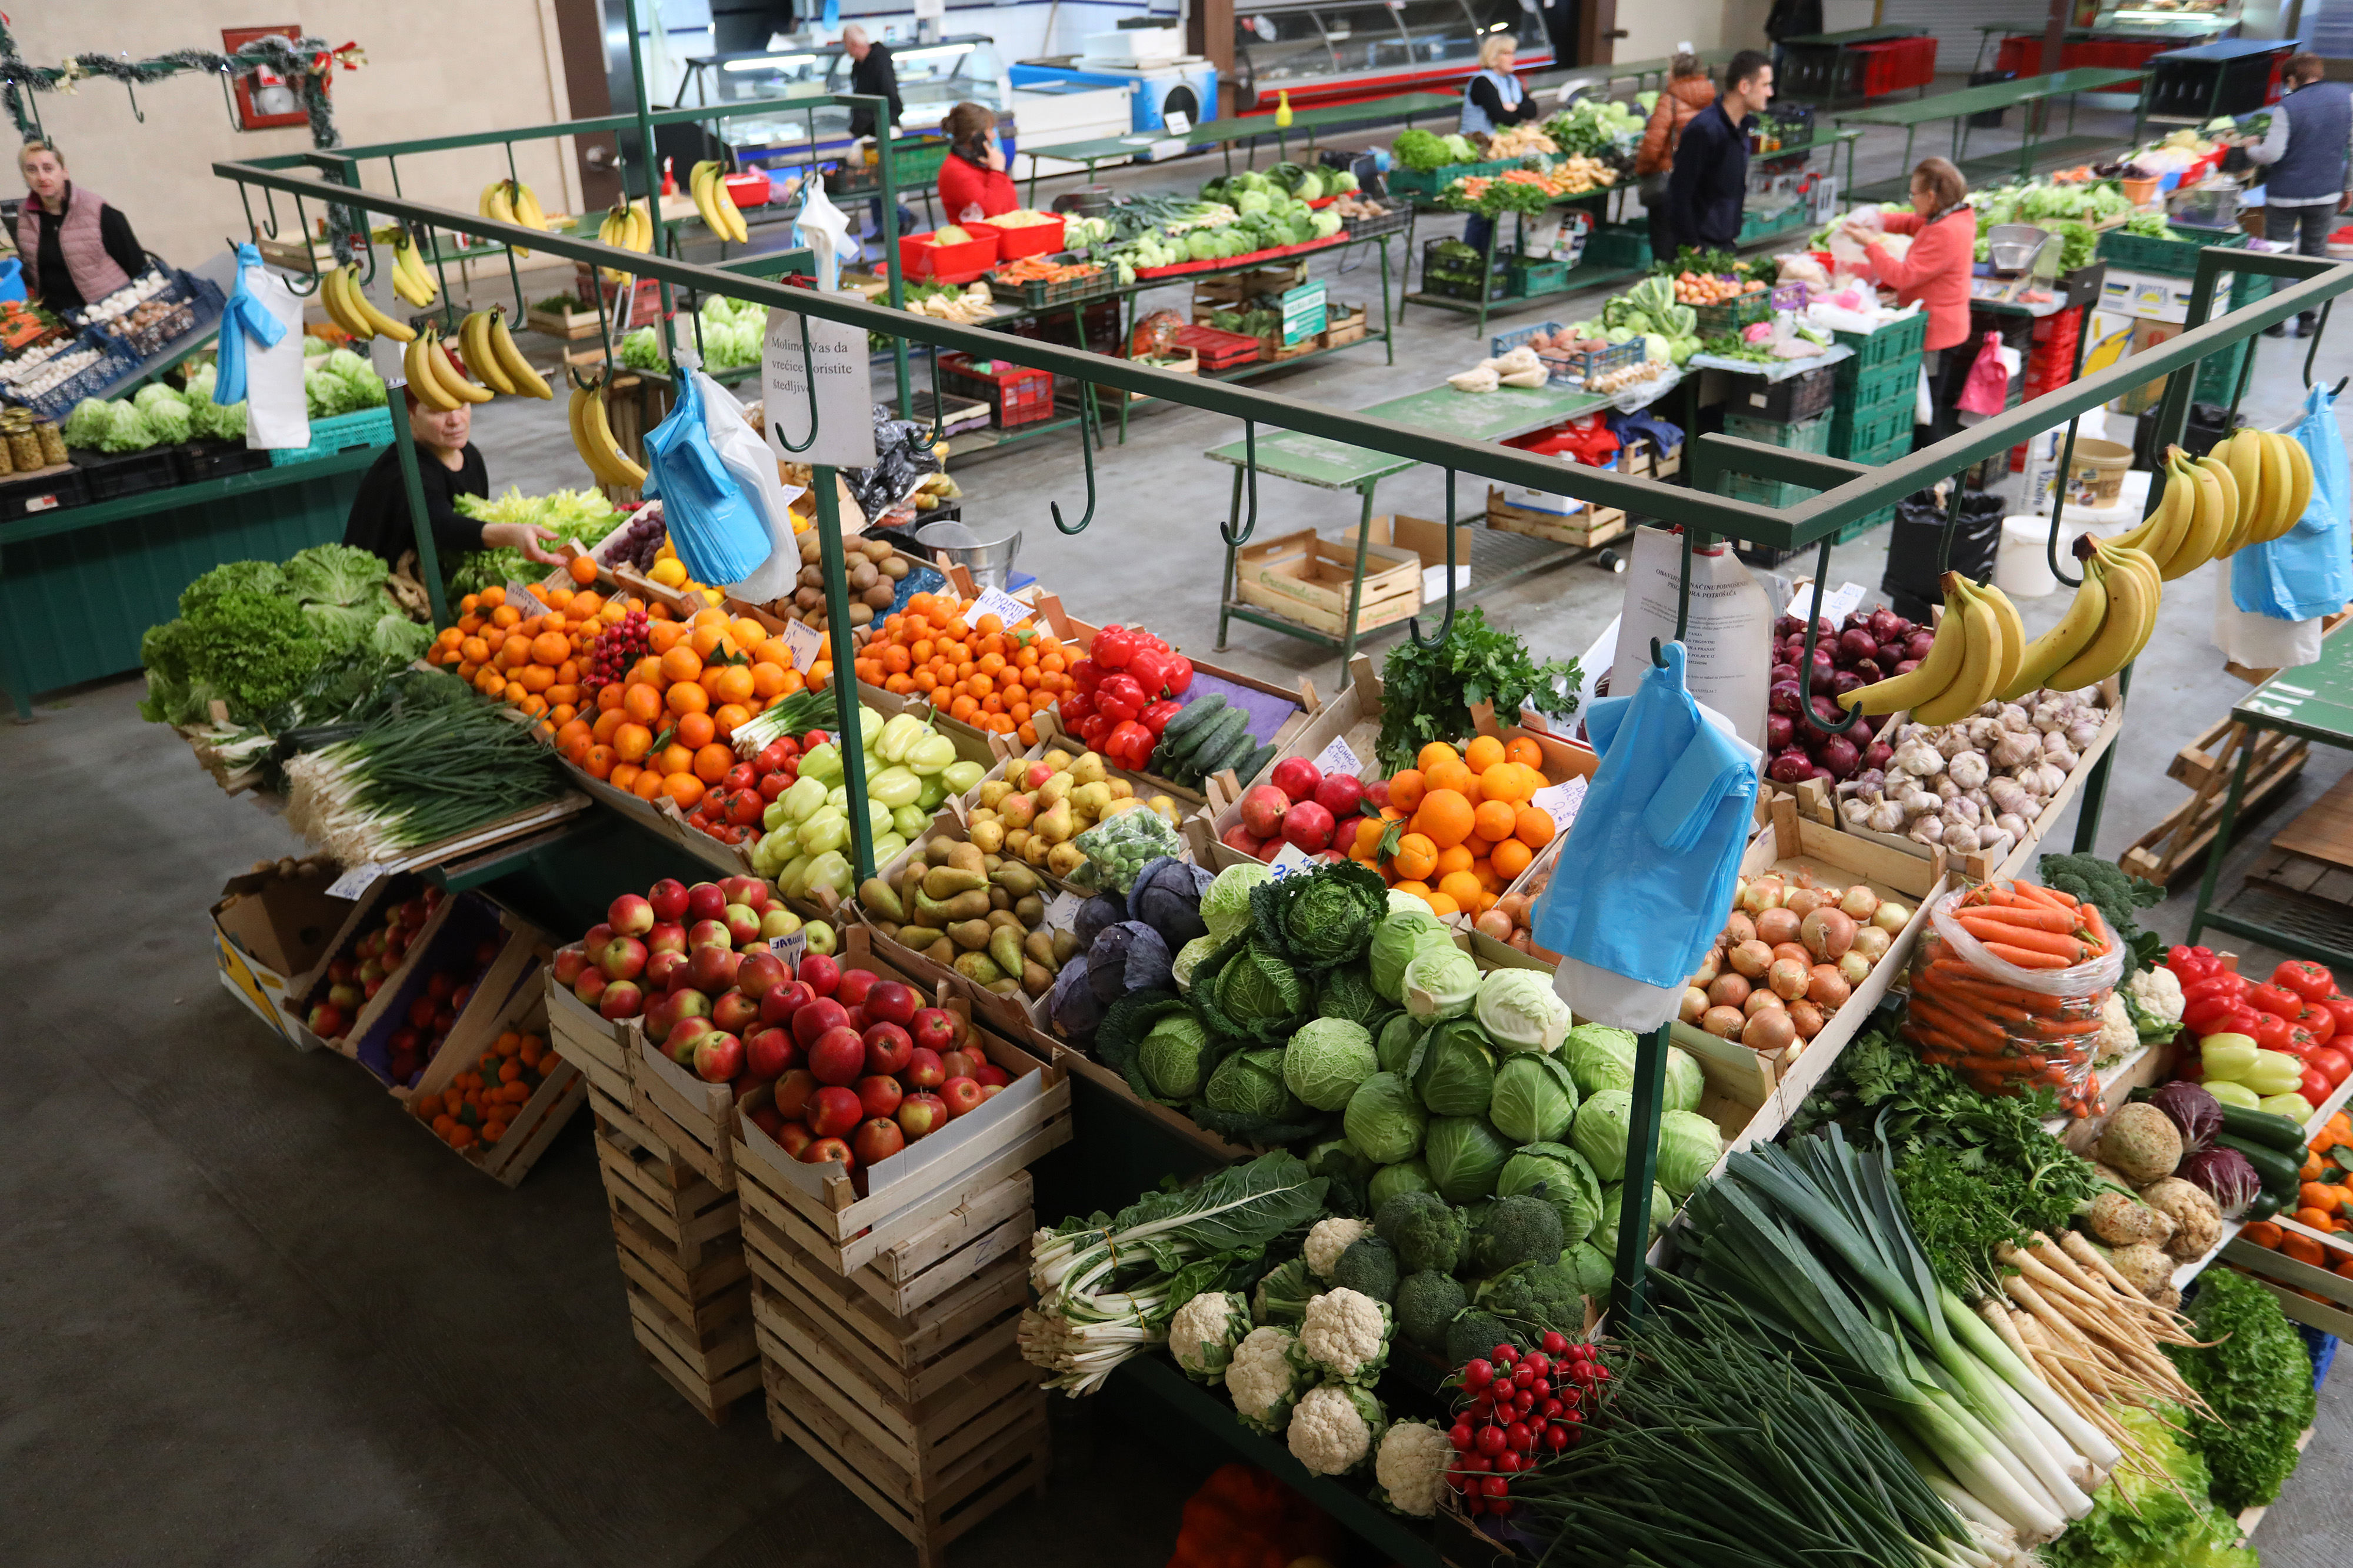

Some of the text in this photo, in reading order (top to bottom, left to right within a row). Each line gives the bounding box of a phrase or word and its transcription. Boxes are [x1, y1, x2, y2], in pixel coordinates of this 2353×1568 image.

[809, 342, 831, 353] Vas
[834, 342, 848, 353] da
[772, 359, 852, 374] vrećice oristite
[1656, 569, 1681, 583] OBAVIJES
